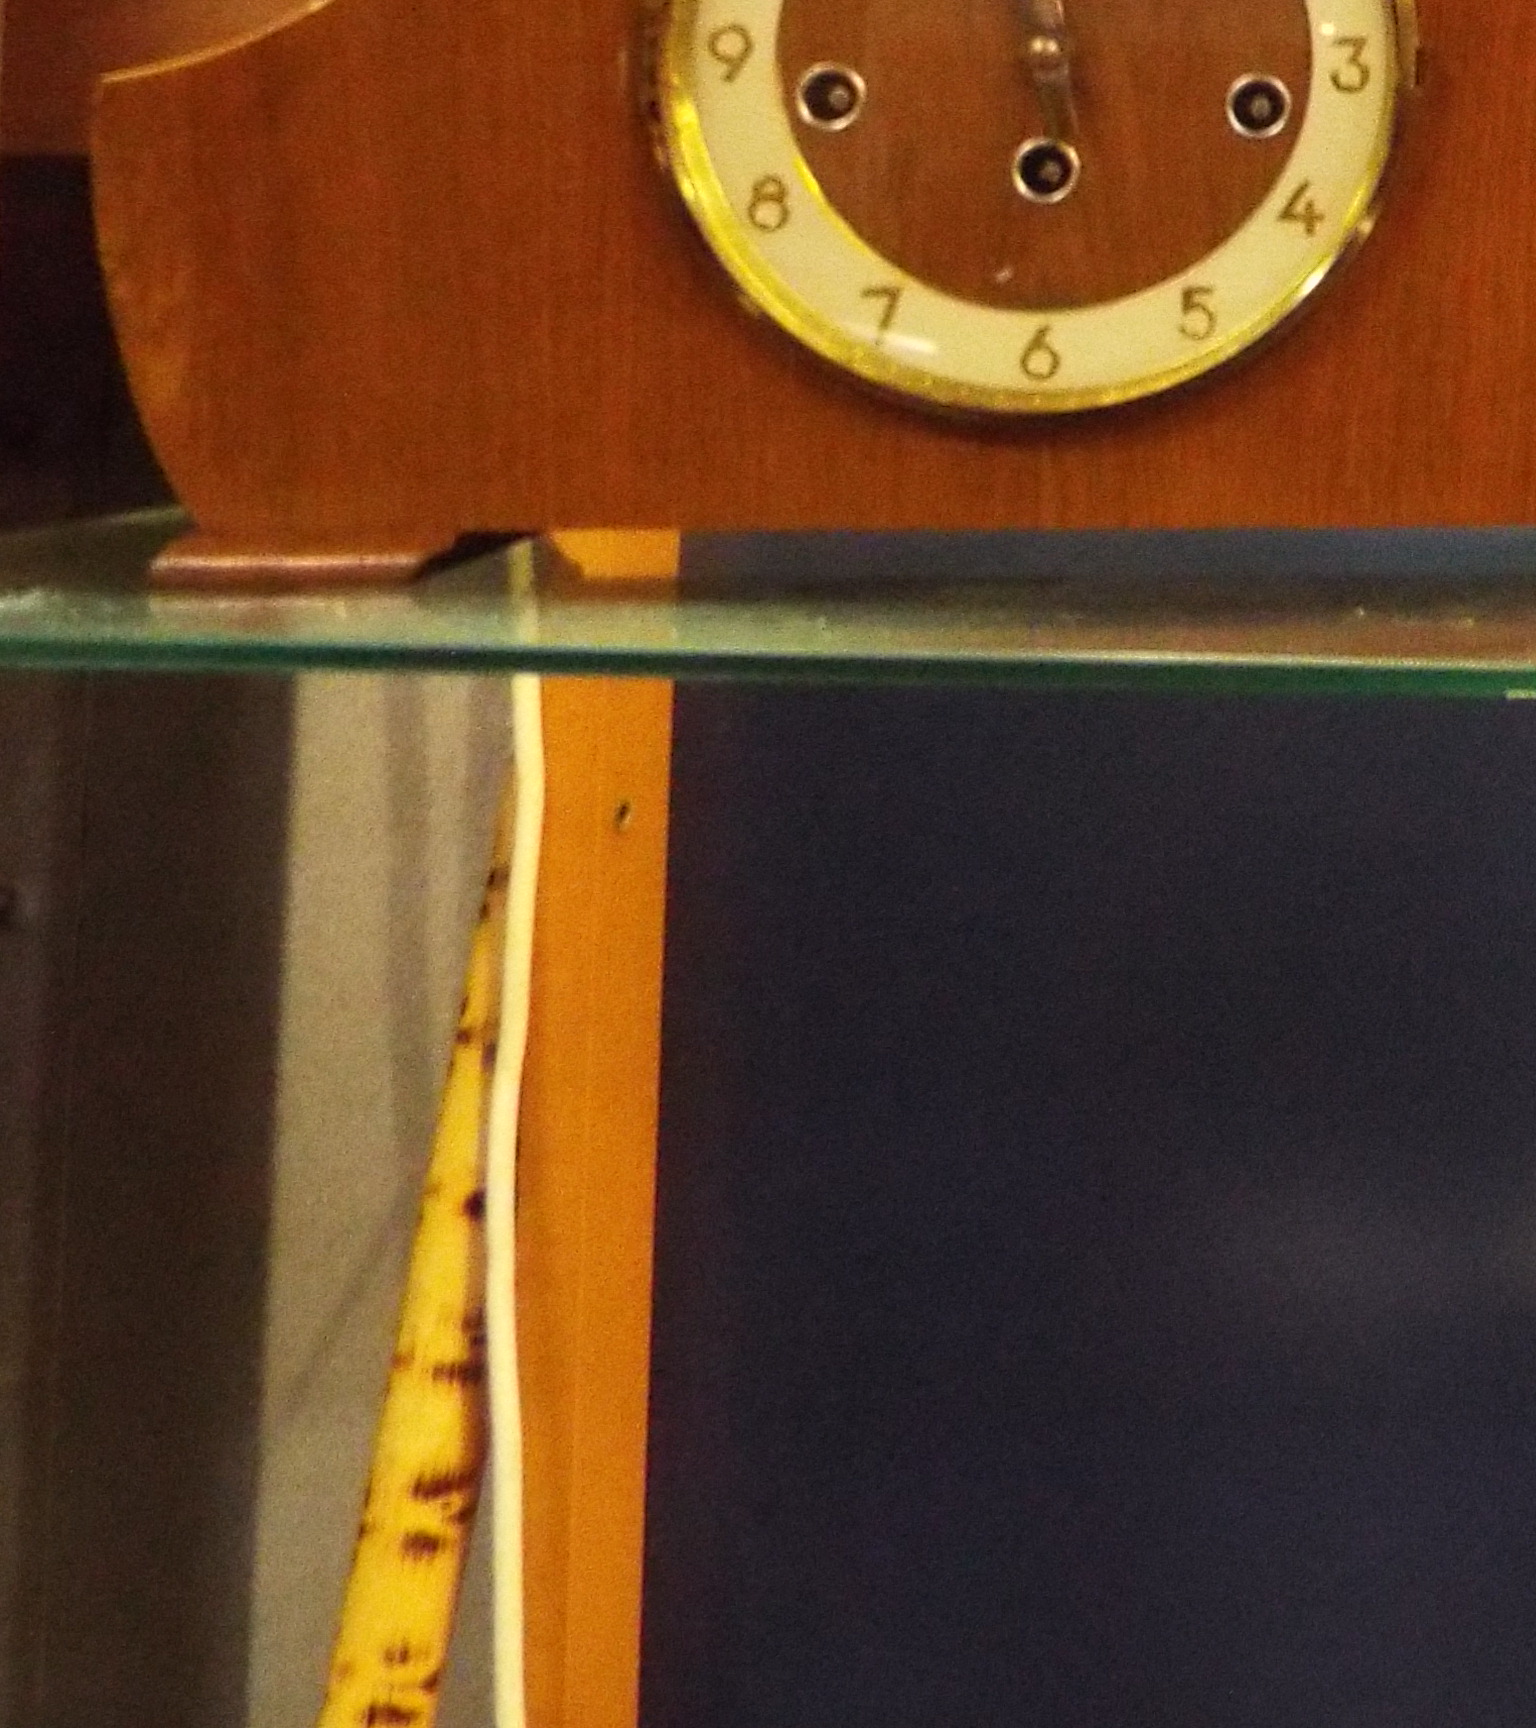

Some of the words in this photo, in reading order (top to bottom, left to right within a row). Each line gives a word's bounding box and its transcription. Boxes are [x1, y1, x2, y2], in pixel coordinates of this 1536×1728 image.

[707, 23, 754, 77] 9
[1330, 36, 1370, 94] 3
[748, 174, 791, 232] 8
[1278, 181, 1325, 237] 4
[860, 286, 902, 346] 7
[1180, 286, 1218, 342] 5
[1019, 325, 1061, 381] 6
